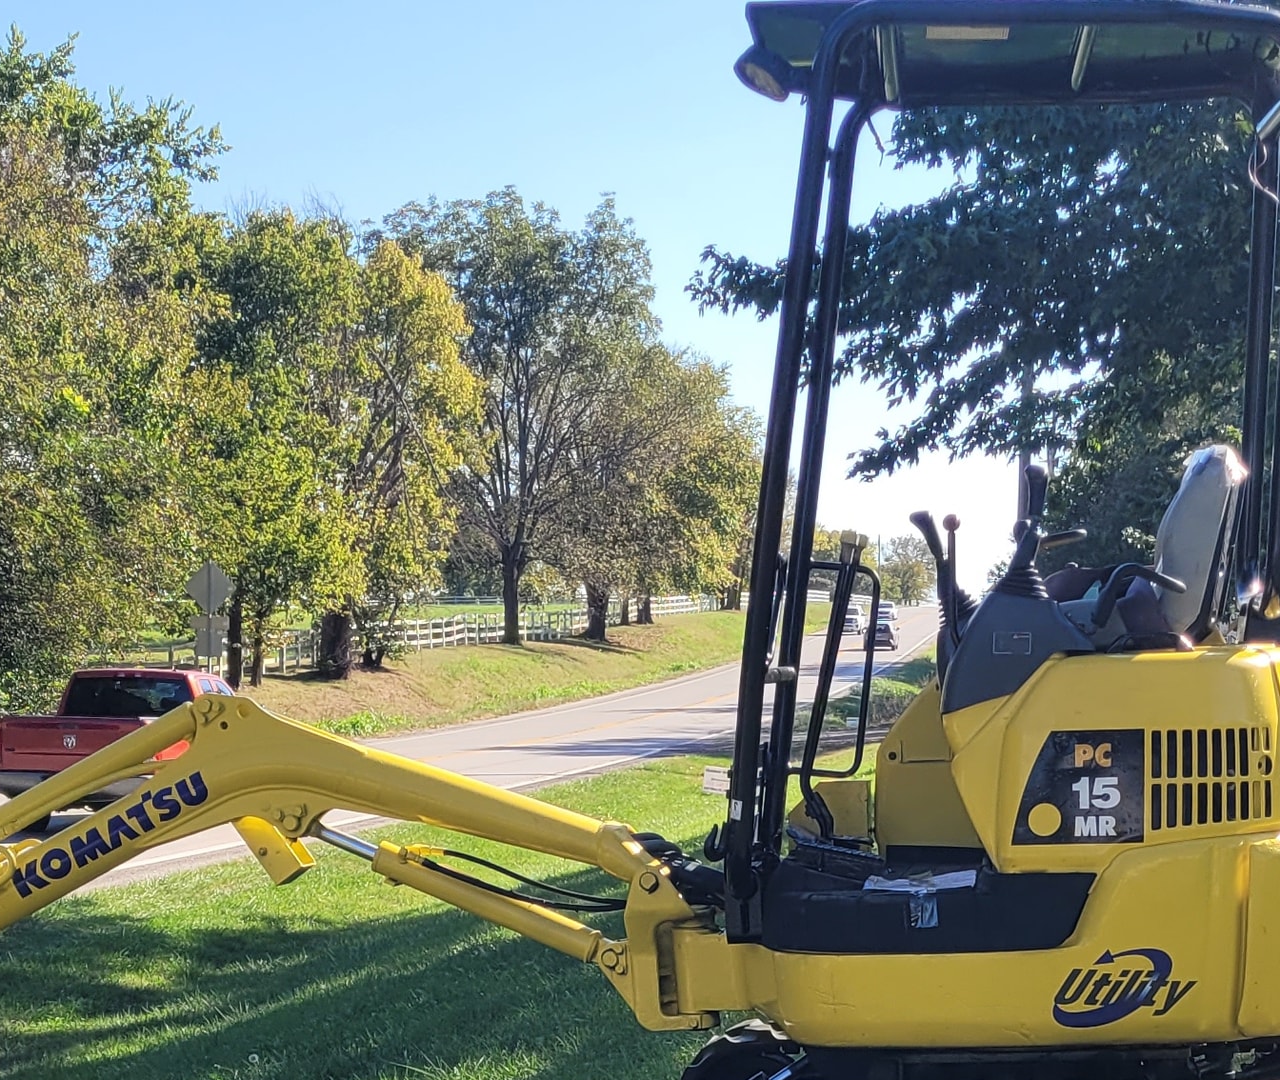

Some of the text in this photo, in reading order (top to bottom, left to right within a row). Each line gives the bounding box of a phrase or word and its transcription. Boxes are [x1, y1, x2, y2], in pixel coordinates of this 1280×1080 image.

[1074, 743, 1112, 768] PC
[1071, 776, 1121, 810] 15
[12, 771, 209, 898] KOMATSU
[1073, 815, 1118, 837] MR
[1053, 968, 1199, 1017] Utility
